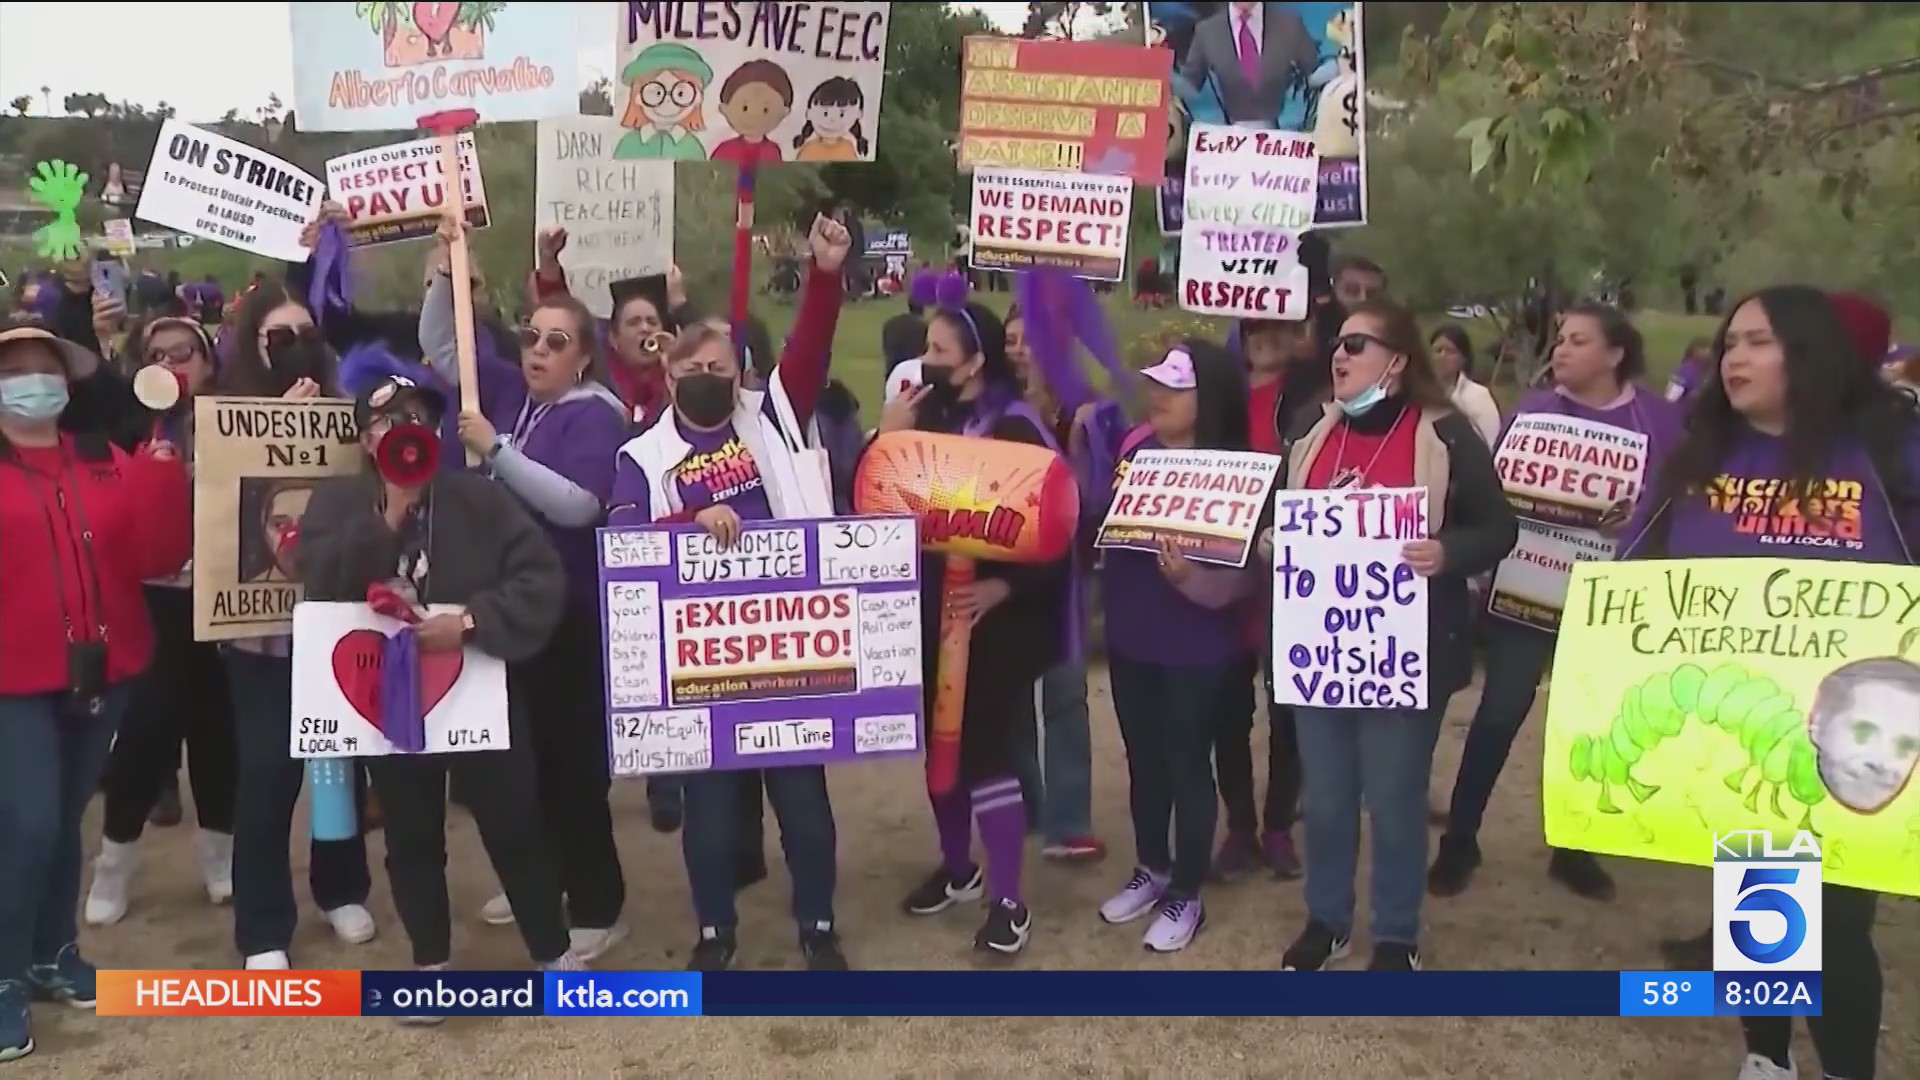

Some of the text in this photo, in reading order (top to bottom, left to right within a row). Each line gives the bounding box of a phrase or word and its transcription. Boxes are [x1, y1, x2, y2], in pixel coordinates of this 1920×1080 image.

[627, 1, 742, 44] MILES
[329, 57, 554, 109] Alberto Carvalho
[968, 72, 1159, 104] ASSISTANTS
[968, 105, 1142, 137] DESERVE A
[351, 155, 378, 170] FEED
[381, 149, 408, 162] OUR
[557, 130, 602, 160] DARN
[968, 140, 1080, 169] RAISE!!!
[169, 134, 315, 206] ON STRIKE!
[340, 161, 429, 192] RESPECT
[577, 166, 636, 191] RICH
[178, 176, 219, 198] Protest
[220, 189, 254, 209] Unfair
[256, 200, 306, 225] Practices
[1012, 177, 1067, 191] ESSENTIAL
[1071, 180, 1103, 193] EVERY
[1107, 185, 1129, 195] DAY
[219, 205, 255, 227] LAUSD
[348, 187, 410, 220] PAY
[979, 189, 1124, 218] WE DEMAND
[978, 214, 1122, 248] RESPECT!
[1201, 230, 1289, 254] TREATED
[1221, 258, 1279, 275] WITH
[1186, 279, 1292, 314] RESPECT
[217, 410, 360, 439] UNDESIRAB
[1505, 434, 1639, 473] WE DEMAND
[1583, 428, 1618, 445] EVERY
[1622, 438, 1644, 451] DAY
[1216, 459, 1248, 471] EVERY
[1251, 461, 1276, 472] DAY
[1497, 456, 1637, 503] RESPECT!
[1128, 470, 1265, 496] WE DEMAND
[1114, 493, 1256, 528] RESPECT!
[1280, 491, 1426, 539] It's TIME
[611, 545, 664, 566] STAFF
[1794, 536, 1841, 548] LOCAL
[682, 553, 803, 582] JUSTICE
[825, 559, 911, 581] Increase
[1276, 545, 1416, 605] to use
[213, 588, 296, 618] ALBERTO
[613, 587, 647, 600] For
[1583, 567, 1920, 626] THE VERY GREEDY
[613, 606, 651, 624] your
[675, 593, 851, 634] ¡EXIGIMOS
[1324, 606, 1385, 633] our
[677, 629, 852, 668] RESPETO!
[863, 646, 917, 660] Vacation
[1631, 623, 1849, 659] CATERPILLAR
[1289, 635, 1421, 678] outside
[675, 680, 748, 696] education
[872, 666, 907, 687] Pay
[300, 718, 338, 734] SEIU
[448, 729, 492, 746] UTLA
[739, 722, 831, 751] Full Time
[299, 737, 340, 753] LOCAL
